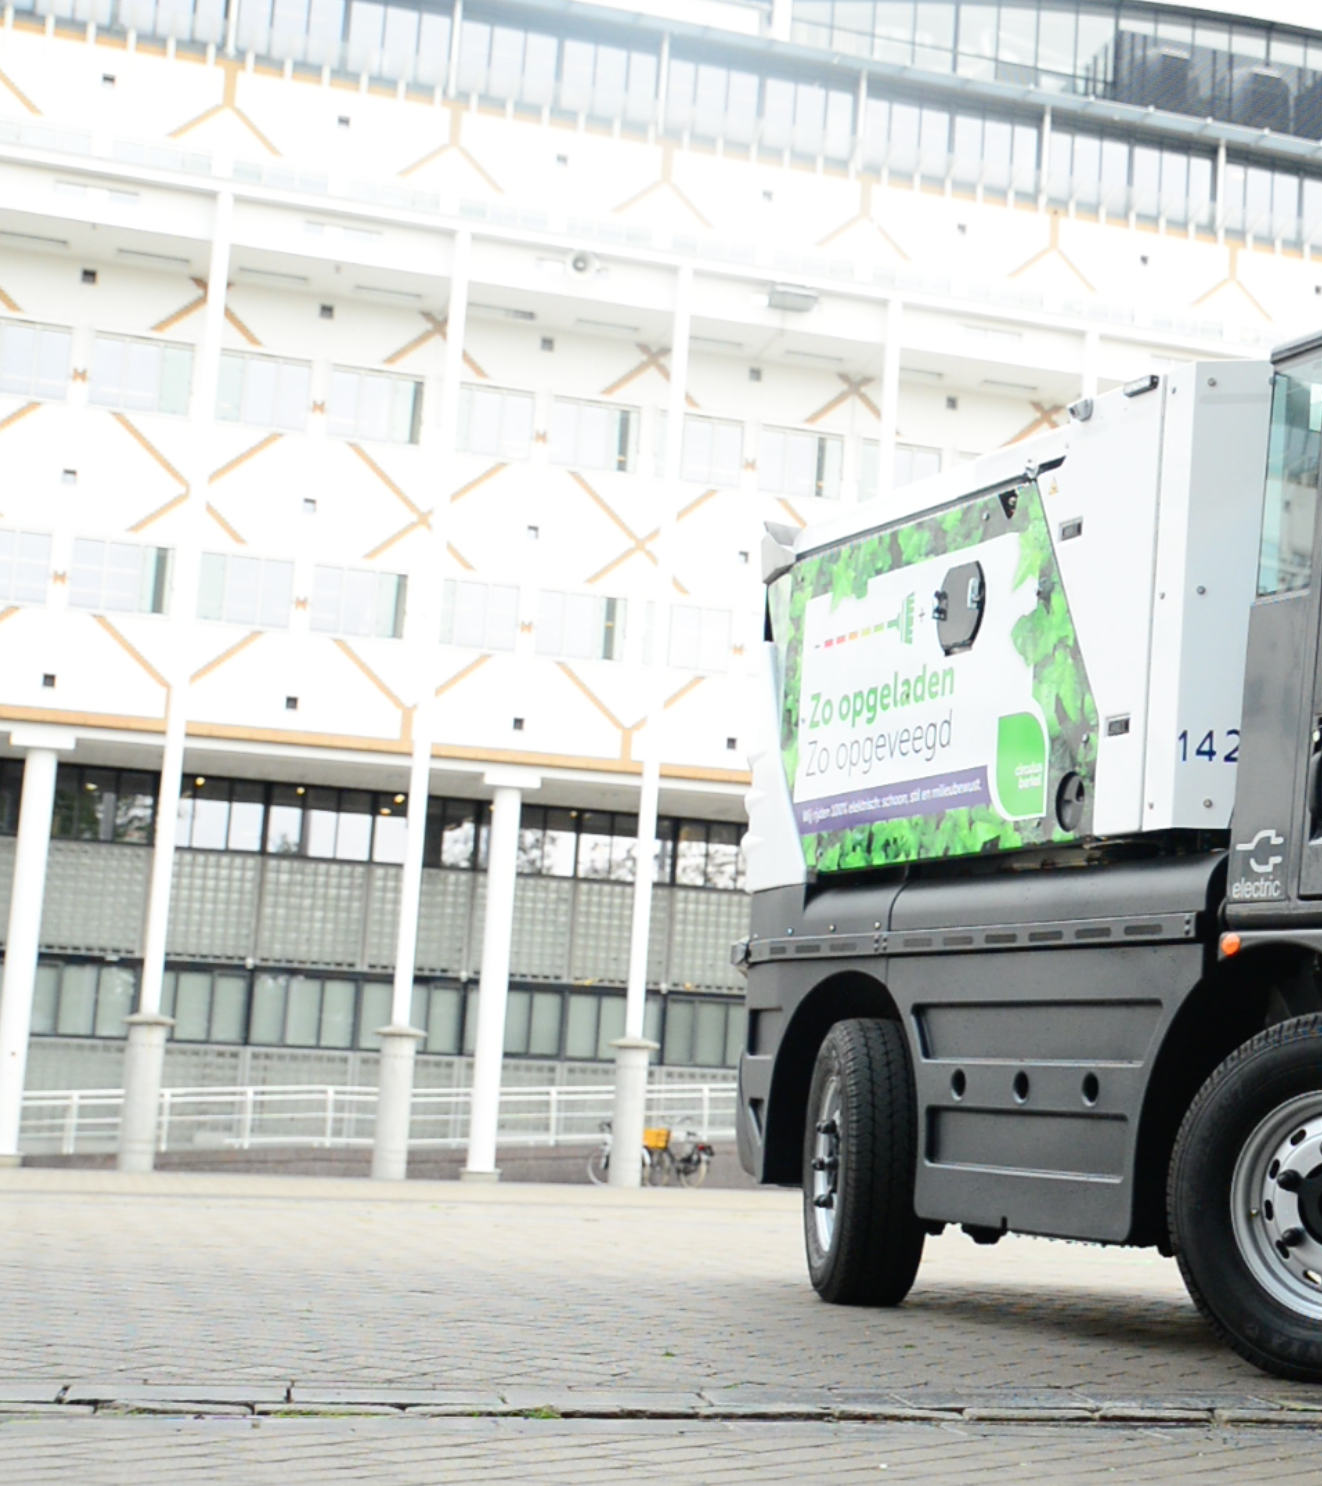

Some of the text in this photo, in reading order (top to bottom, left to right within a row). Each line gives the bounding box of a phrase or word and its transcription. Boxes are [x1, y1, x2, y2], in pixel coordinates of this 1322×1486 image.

[808, 664, 955, 730] Zo opgeladen
[805, 708, 953, 778] Zo opgeveegd
[1232, 875, 1281, 899] electric
